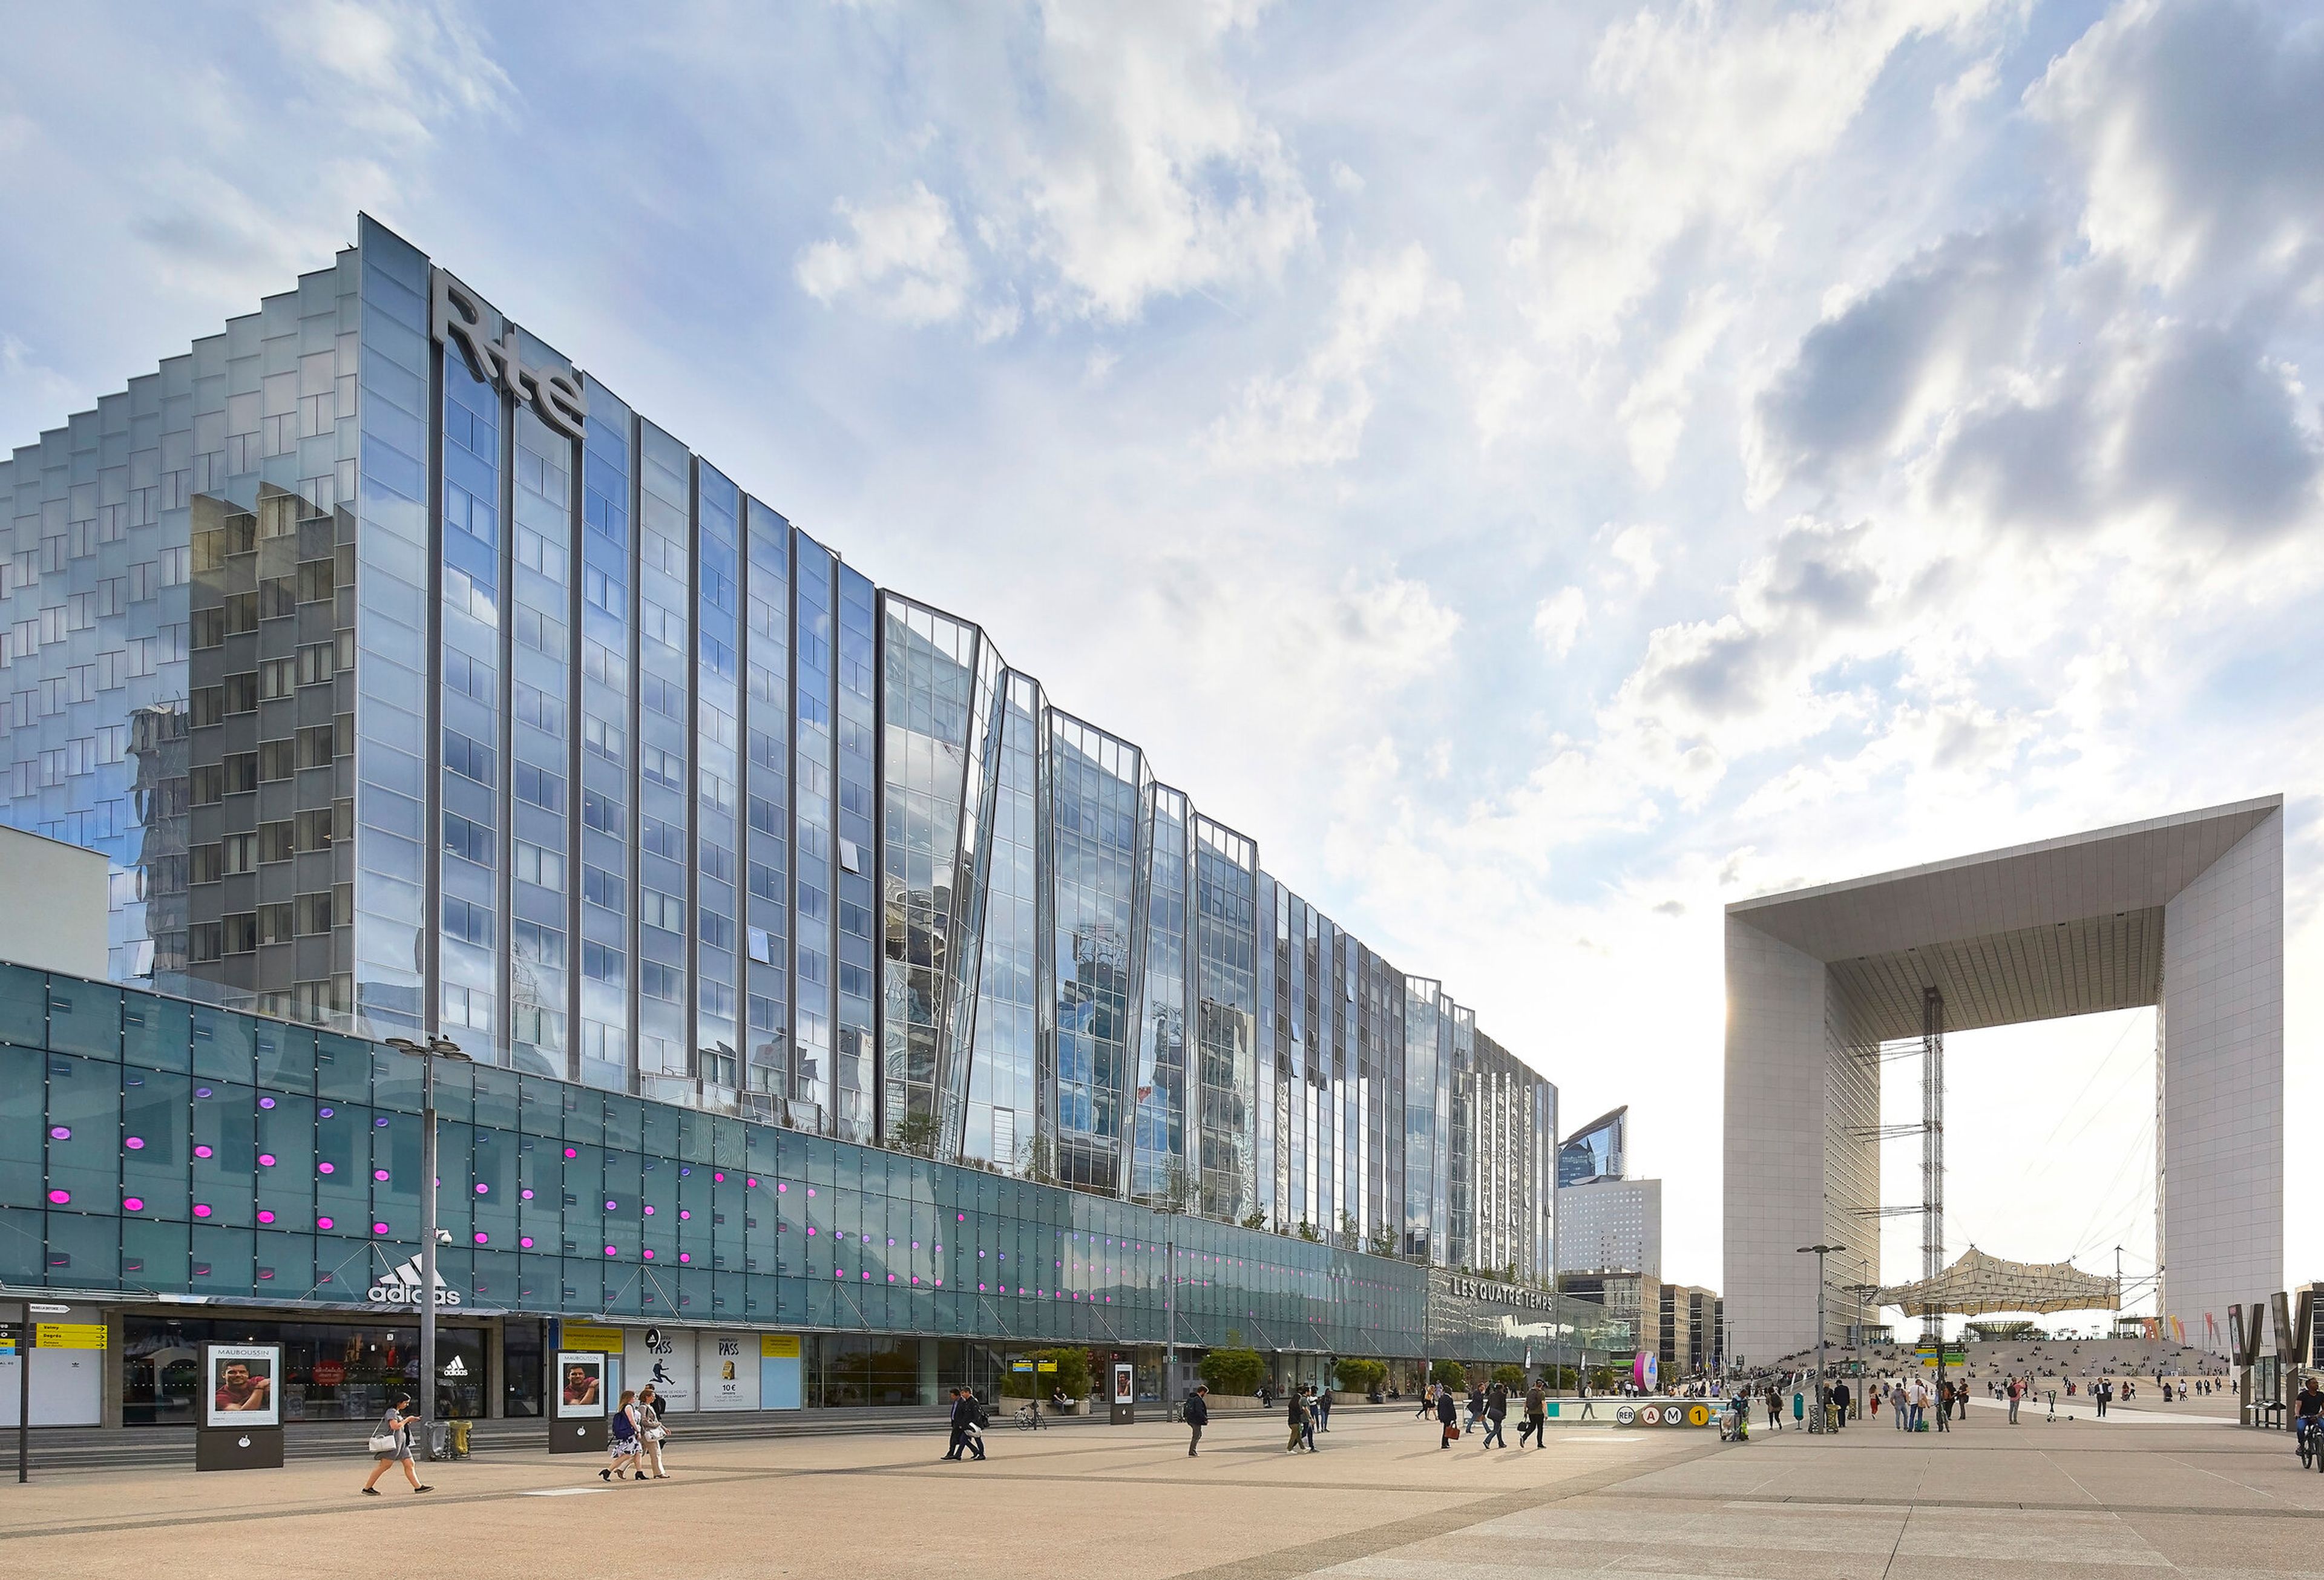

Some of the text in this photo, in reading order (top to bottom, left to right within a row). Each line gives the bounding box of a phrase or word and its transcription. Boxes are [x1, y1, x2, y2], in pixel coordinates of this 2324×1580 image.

[432, 267, 589, 440] Rte
[1454, 1277, 1552, 1311] LES QUATRE TEMPS
[719, 1342, 739, 1355] PASS
[1619, 1411, 1701, 1421] RER A M 1
